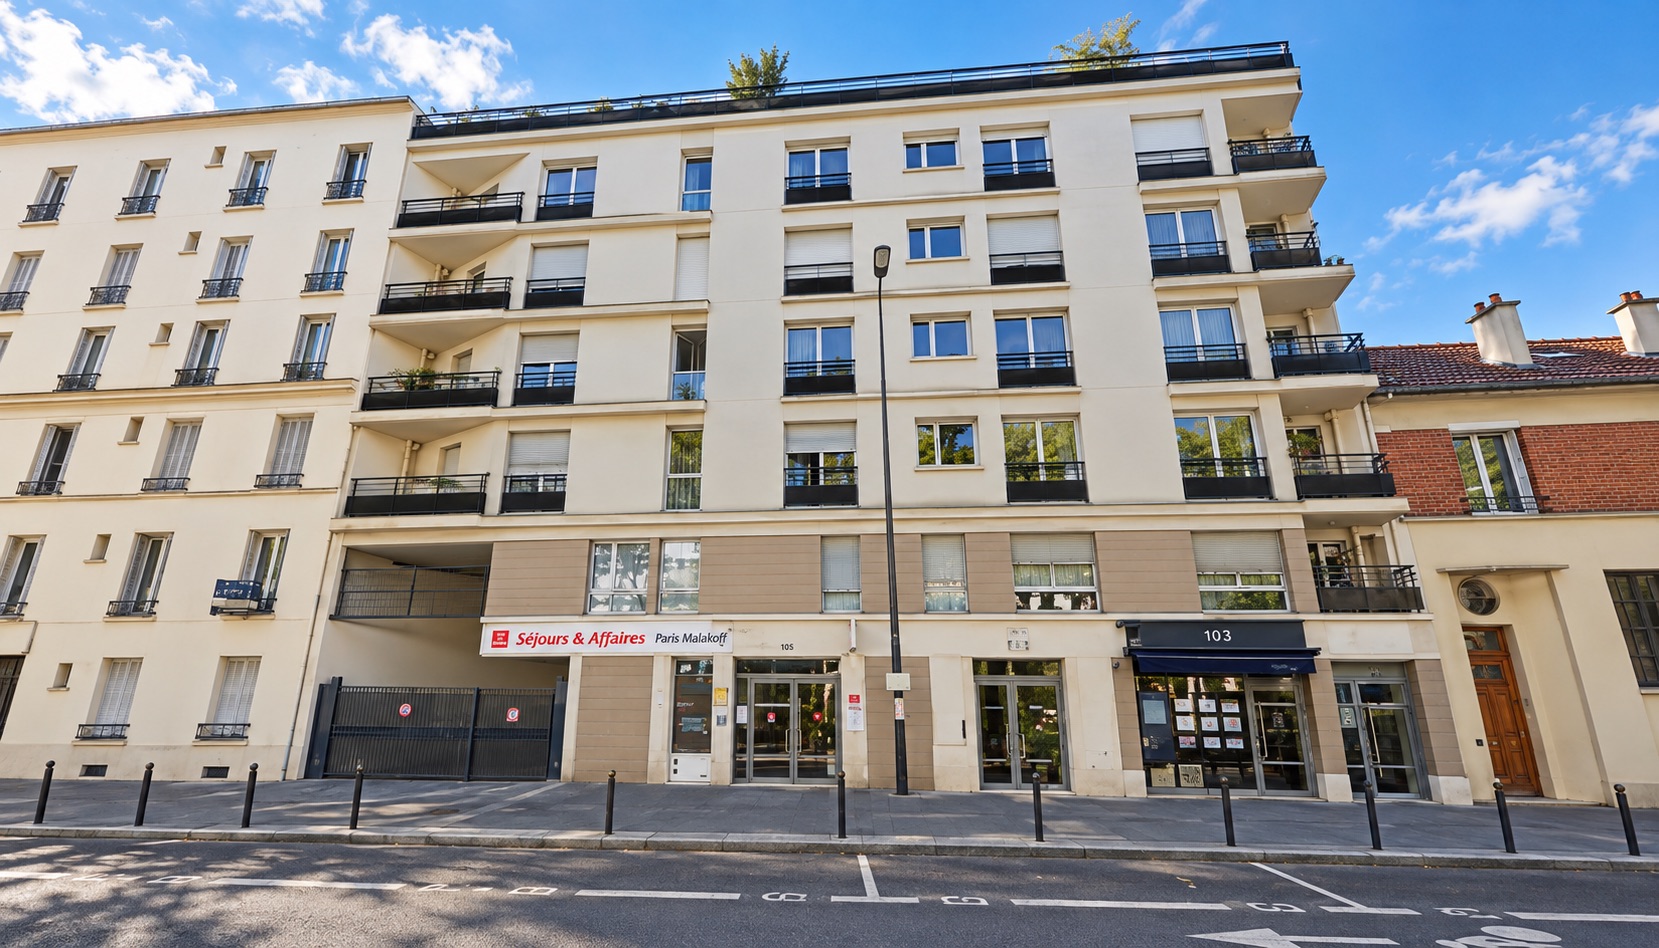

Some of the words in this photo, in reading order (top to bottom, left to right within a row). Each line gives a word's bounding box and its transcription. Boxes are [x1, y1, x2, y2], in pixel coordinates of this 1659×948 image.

[516, 632, 569, 649] Séjours
[572, 631, 584, 645] &
[587, 631, 646, 648] Affaires
[654, 633, 679, 644] Paris
[681, 632, 728, 647] Malakoff
[1204, 629, 1232, 642] 103
